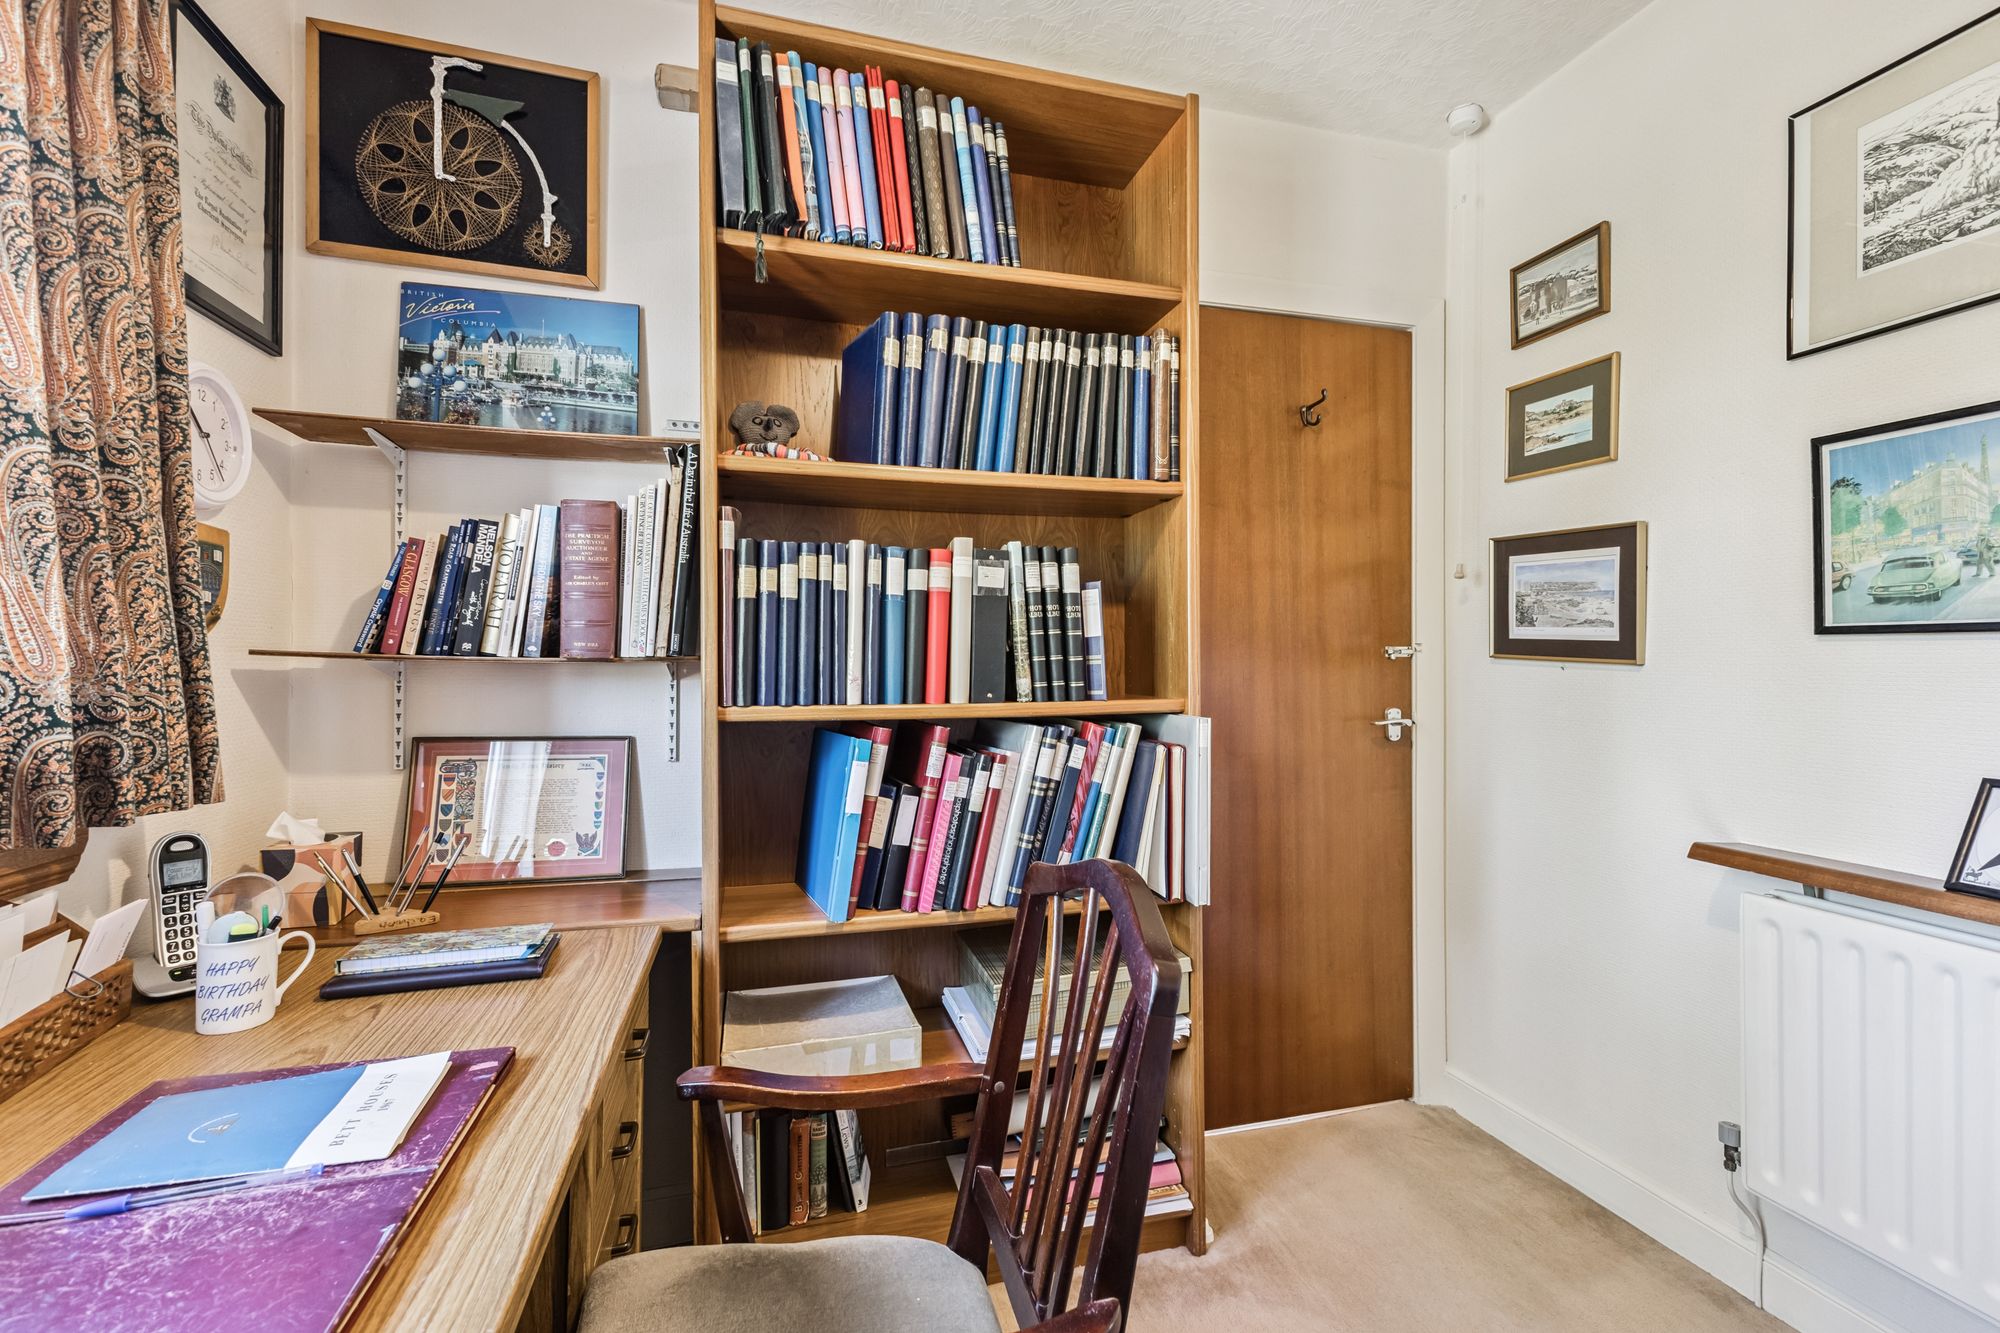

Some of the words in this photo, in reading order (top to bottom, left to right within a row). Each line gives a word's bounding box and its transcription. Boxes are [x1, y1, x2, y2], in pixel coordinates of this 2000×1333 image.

[401, 288, 444, 298] BRITISH
[405, 297, 475, 318] Victoria
[440, 318, 496, 327] COLUMBIA
[198, 389, 207, 402] 12
[221, 418, 226, 430] 2
[225, 440, 229, 452] 3
[197, 469, 201, 481] 6
[210, 469, 214, 480] 5
[687, 461, 698, 478] Day
[686, 479, 696, 487] in
[685, 487, 696, 504] the
[638, 493, 646, 530] SURVEYING
[646, 501, 654, 531] OFFICIAL
[683, 504, 695, 518] Life
[447, 543, 457, 560] ROAD
[471, 524, 485, 574] MANDELA
[482, 525, 497, 567] NELSON
[500, 537, 516, 567] MO
[636, 529, 644, 566] BUILDINGS
[680, 526, 692, 564] Australia
[537, 560, 546, 582] FROM
[642, 532, 653, 594] COMMONWEALTH
[398, 552, 418, 597] GLASGOW
[437, 565, 452, 604] GRANTCHESTER
[486, 570, 509, 629] FARAH
[535, 583, 544, 599] THE
[371, 598, 383, 619] Cryptic
[411, 579, 428, 632] VIKINGS
[532, 600, 543, 616] SKY
[640, 594, 648, 618] GAMES
[357, 619, 374, 648] Crossword
[184, 914, 189, 922] 2
[206, 955, 260, 976] HAPPY
[198, 975, 270, 999] BIRTHDAY
[201, 998, 263, 1024] GRAMPA
[329, 1119, 361, 1147] BETT
[356, 1073, 398, 1112] HOUSES
[841, 1126, 850, 1149] Lews
